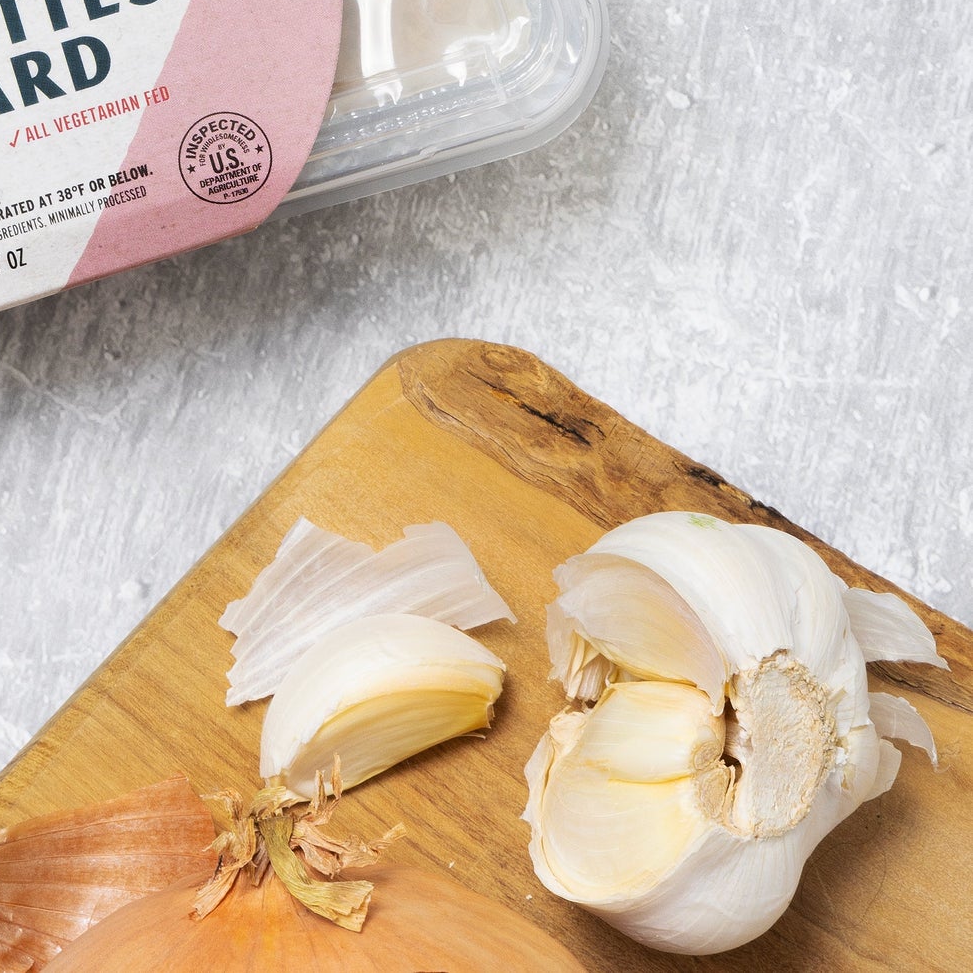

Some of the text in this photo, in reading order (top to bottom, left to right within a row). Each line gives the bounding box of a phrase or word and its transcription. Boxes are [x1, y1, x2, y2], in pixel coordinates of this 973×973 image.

[24, 85, 170, 143] ALL VEGETARIAN FED
[185, 118, 257, 160] INSPECTED
[198, 132, 251, 167] FOR WHOLESOMENESS
[217, 142, 226, 151] BY
[199, 162, 263, 189] DEPARTMENT OF
[208, 147, 245, 174] U.S.
[38, 192, 54, 208] AT
[56, 183, 85, 202] 38°F
[88, 177, 107, 193] OR
[107, 164, 154, 187] BELOW.
[208, 173, 260, 196] AGRICULTURE
[47, 200, 96, 225] MINIMALLY
[97, 185, 147, 209] PROCESSED
[6, 247, 28, 270] OZ
